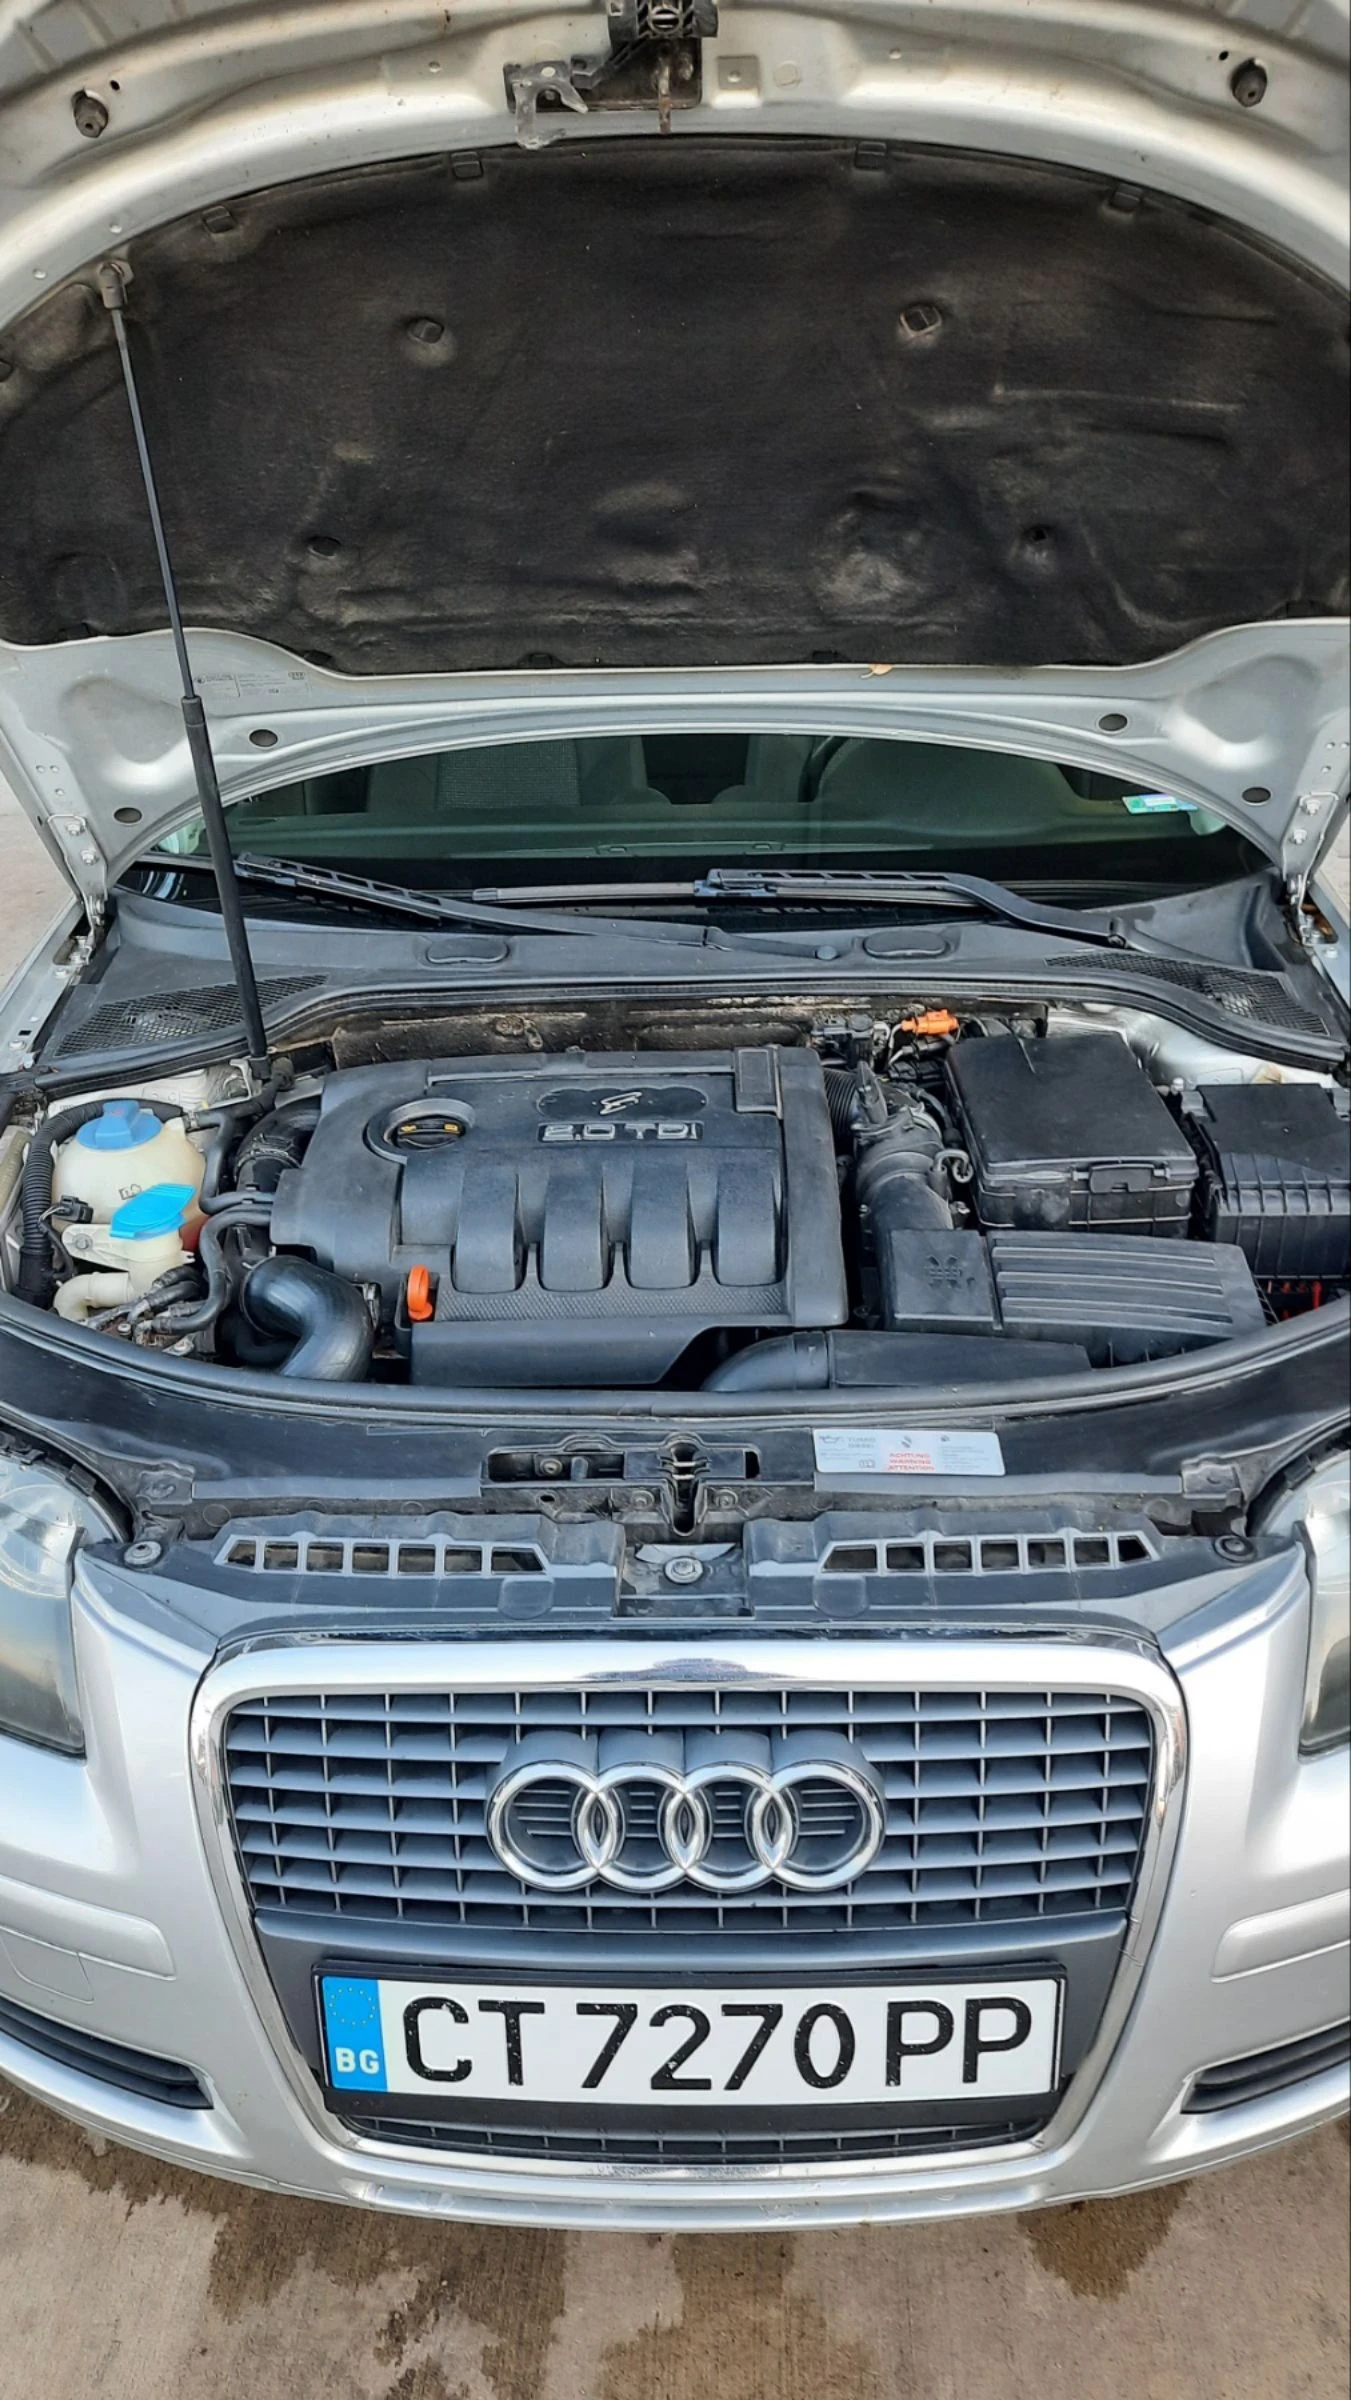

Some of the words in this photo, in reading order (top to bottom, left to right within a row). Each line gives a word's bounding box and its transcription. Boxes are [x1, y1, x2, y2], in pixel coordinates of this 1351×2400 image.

[542, 1123, 616, 1141] 2.0
[624, 1122, 698, 1140] TDI
[402, 1995, 545, 2087] CT
[576, 2002, 856, 2091] 7270
[885, 1995, 1033, 2088] PP
[335, 2047, 380, 2075] BG
